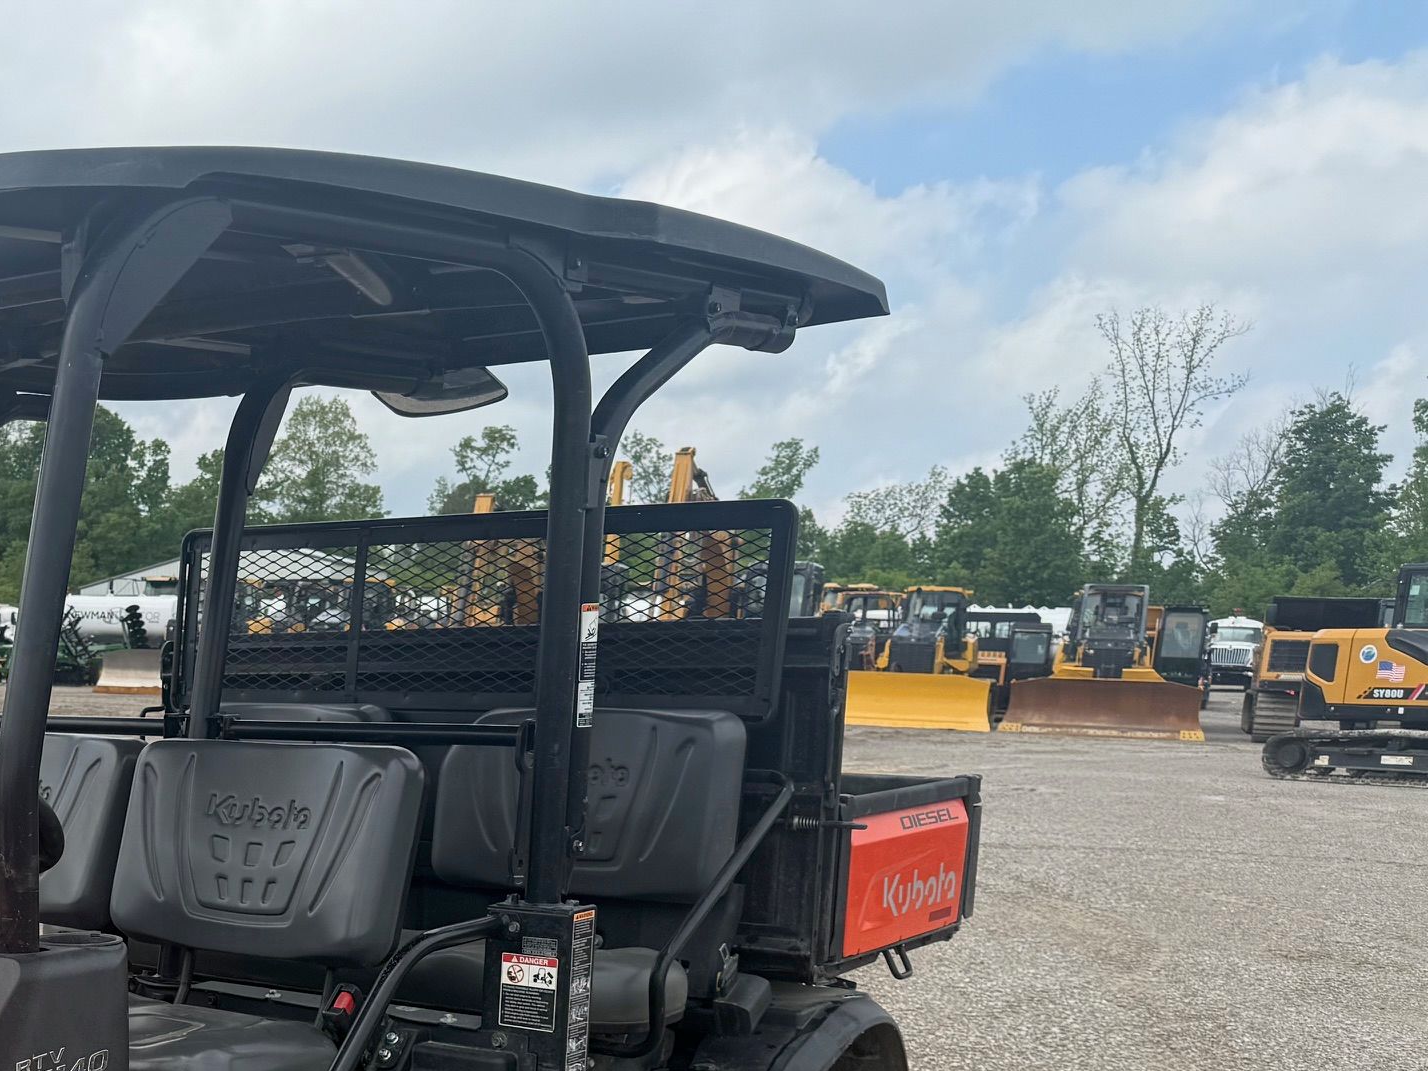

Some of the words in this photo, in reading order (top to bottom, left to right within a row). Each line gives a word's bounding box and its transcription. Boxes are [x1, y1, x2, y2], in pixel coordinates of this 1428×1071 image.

[1373, 688, 1404, 699] SY80U
[205, 793, 312, 830] Kubota
[899, 807, 959, 830] DIESEL
[883, 862, 957, 917] Kubota
[519, 956, 549, 966] DANGER
